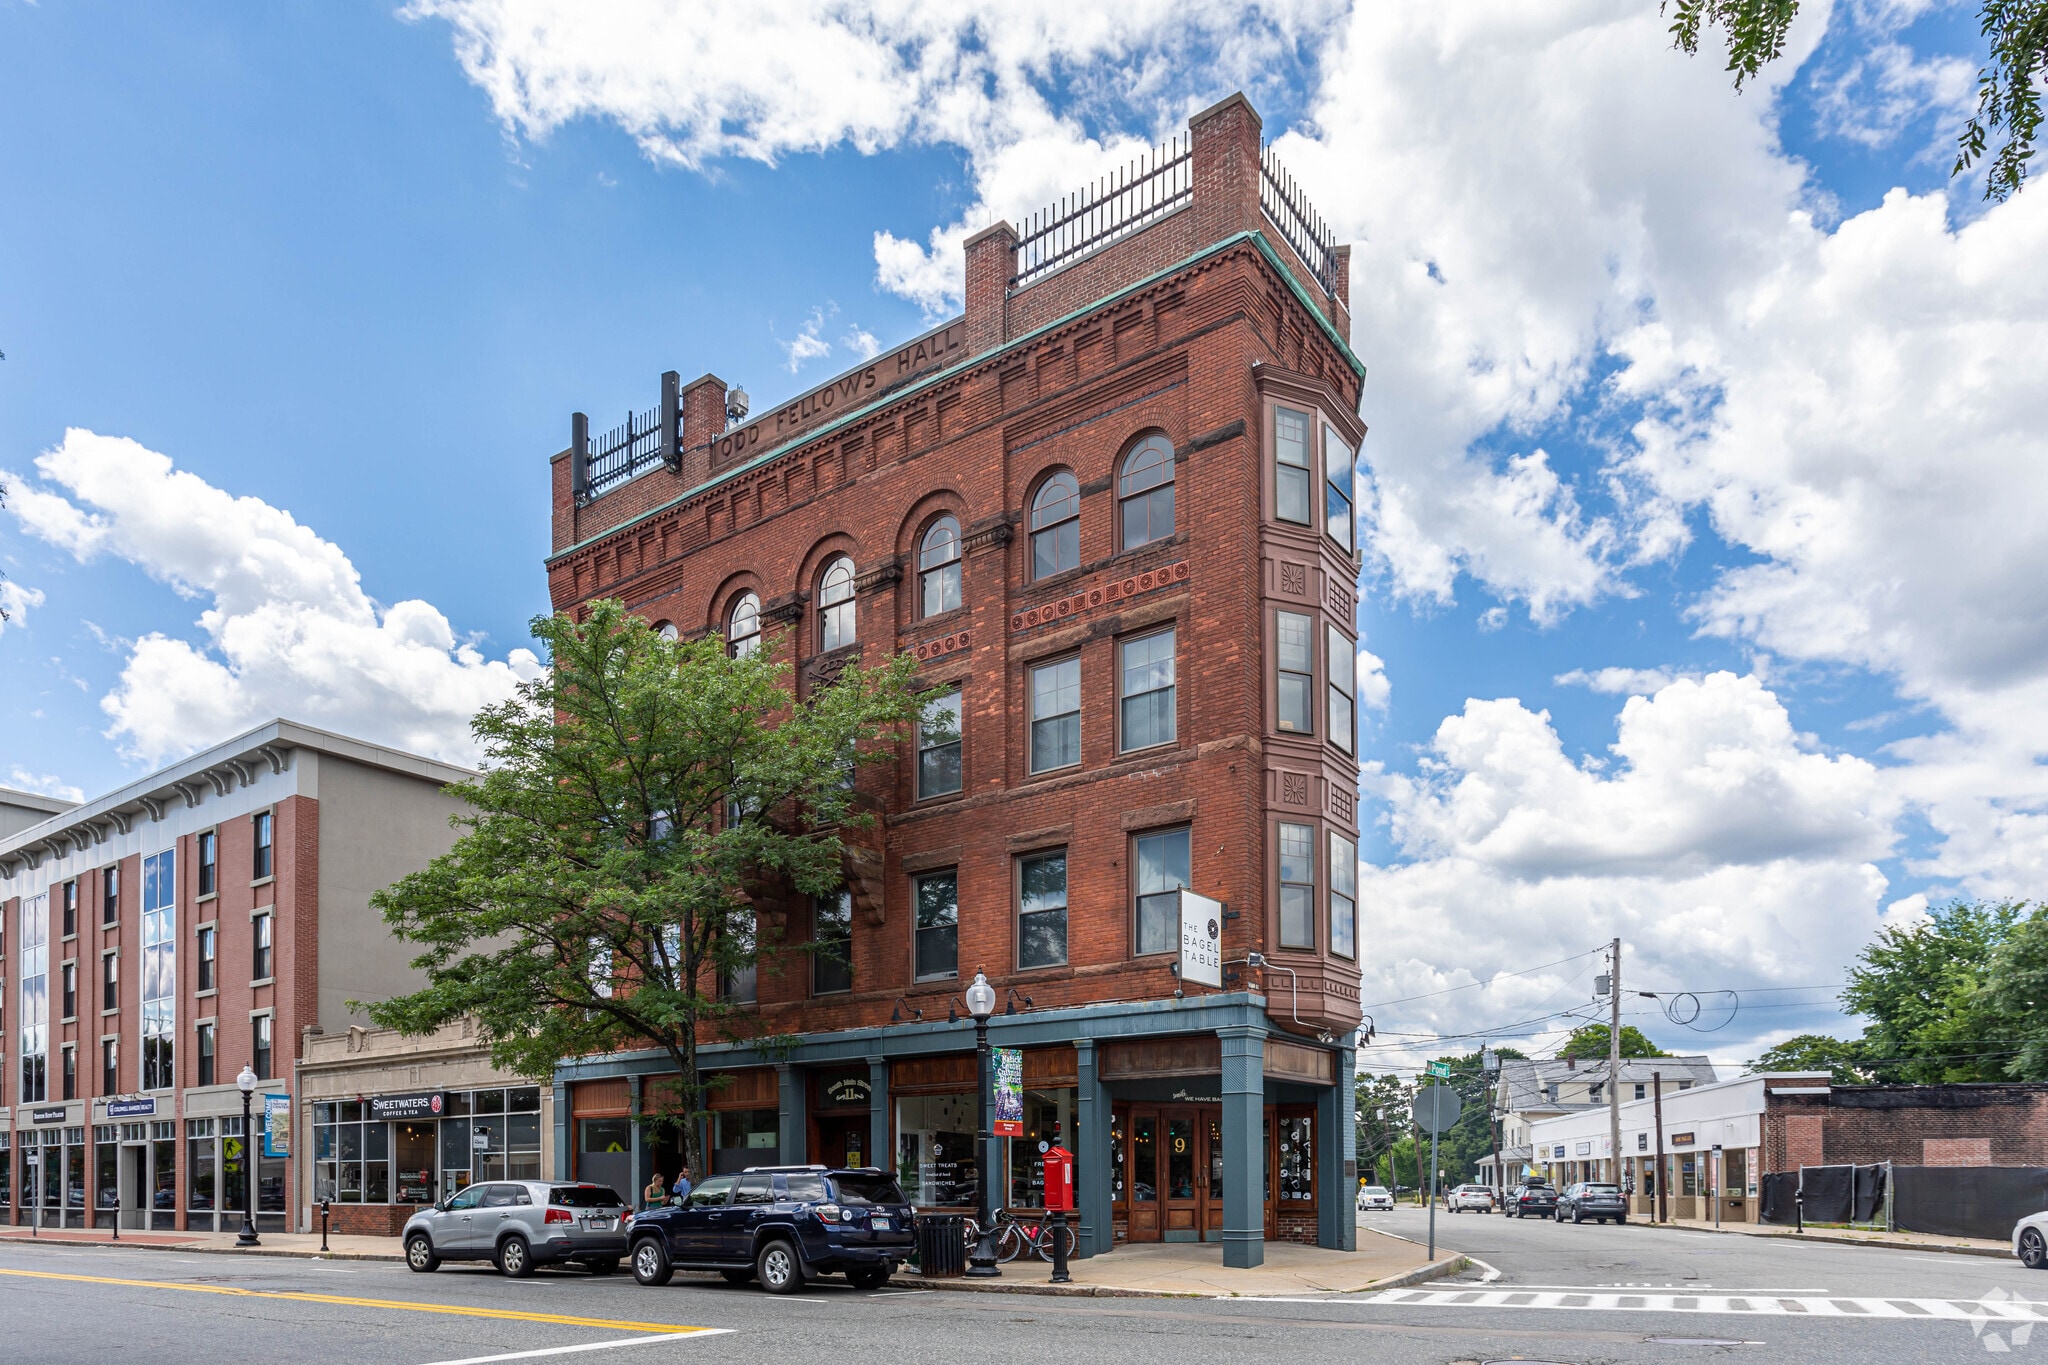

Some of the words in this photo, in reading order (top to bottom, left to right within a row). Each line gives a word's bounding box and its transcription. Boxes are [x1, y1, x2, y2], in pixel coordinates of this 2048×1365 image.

[721, 425, 760, 457] ODD
[776, 367, 876, 431] FELLOWS
[897, 330, 959, 374] HALL
[1183, 921, 1198, 933] THE
[1183, 934, 1219, 954] BAGEL
[1183, 949, 1219, 968] TABLE
[1431, 1062, 1447, 1076] Pond
[1174, 1137, 1186, 1153] 9
